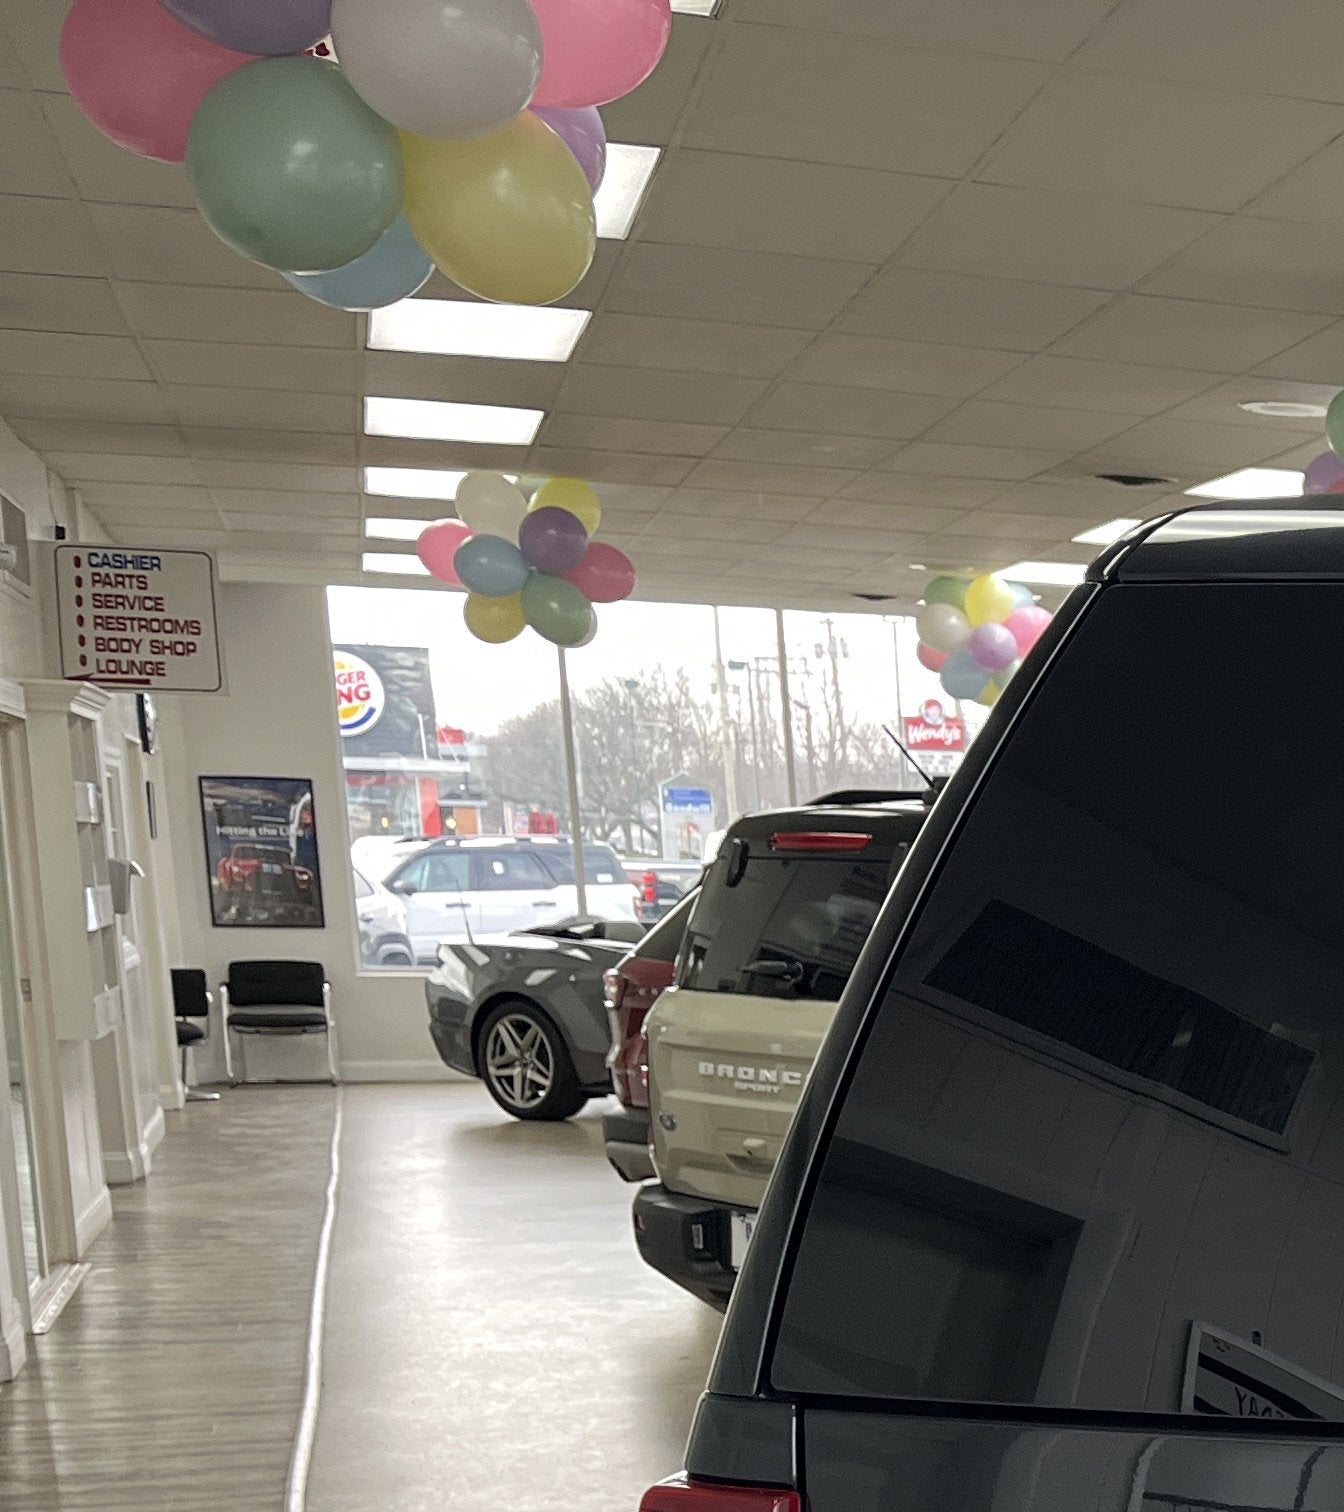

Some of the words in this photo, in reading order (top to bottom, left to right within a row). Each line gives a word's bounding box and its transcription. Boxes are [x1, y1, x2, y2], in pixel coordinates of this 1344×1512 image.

[87, 552, 162, 571] CASHIER
[91, 572, 148, 590] PARTS
[91, 593, 165, 612] SERVICE
[93, 615, 201, 635] RESTROOMS
[94, 637, 143, 654] BODY
[150, 639, 197, 656] SHOP
[96, 658, 166, 677] LOUNGE
[336, 670, 366, 685] GER
[336, 684, 371, 705] NG
[907, 723, 961, 745] Wendy's
[698, 1061, 806, 1086] BRONC
[734, 1081, 781, 1093] SPORT
